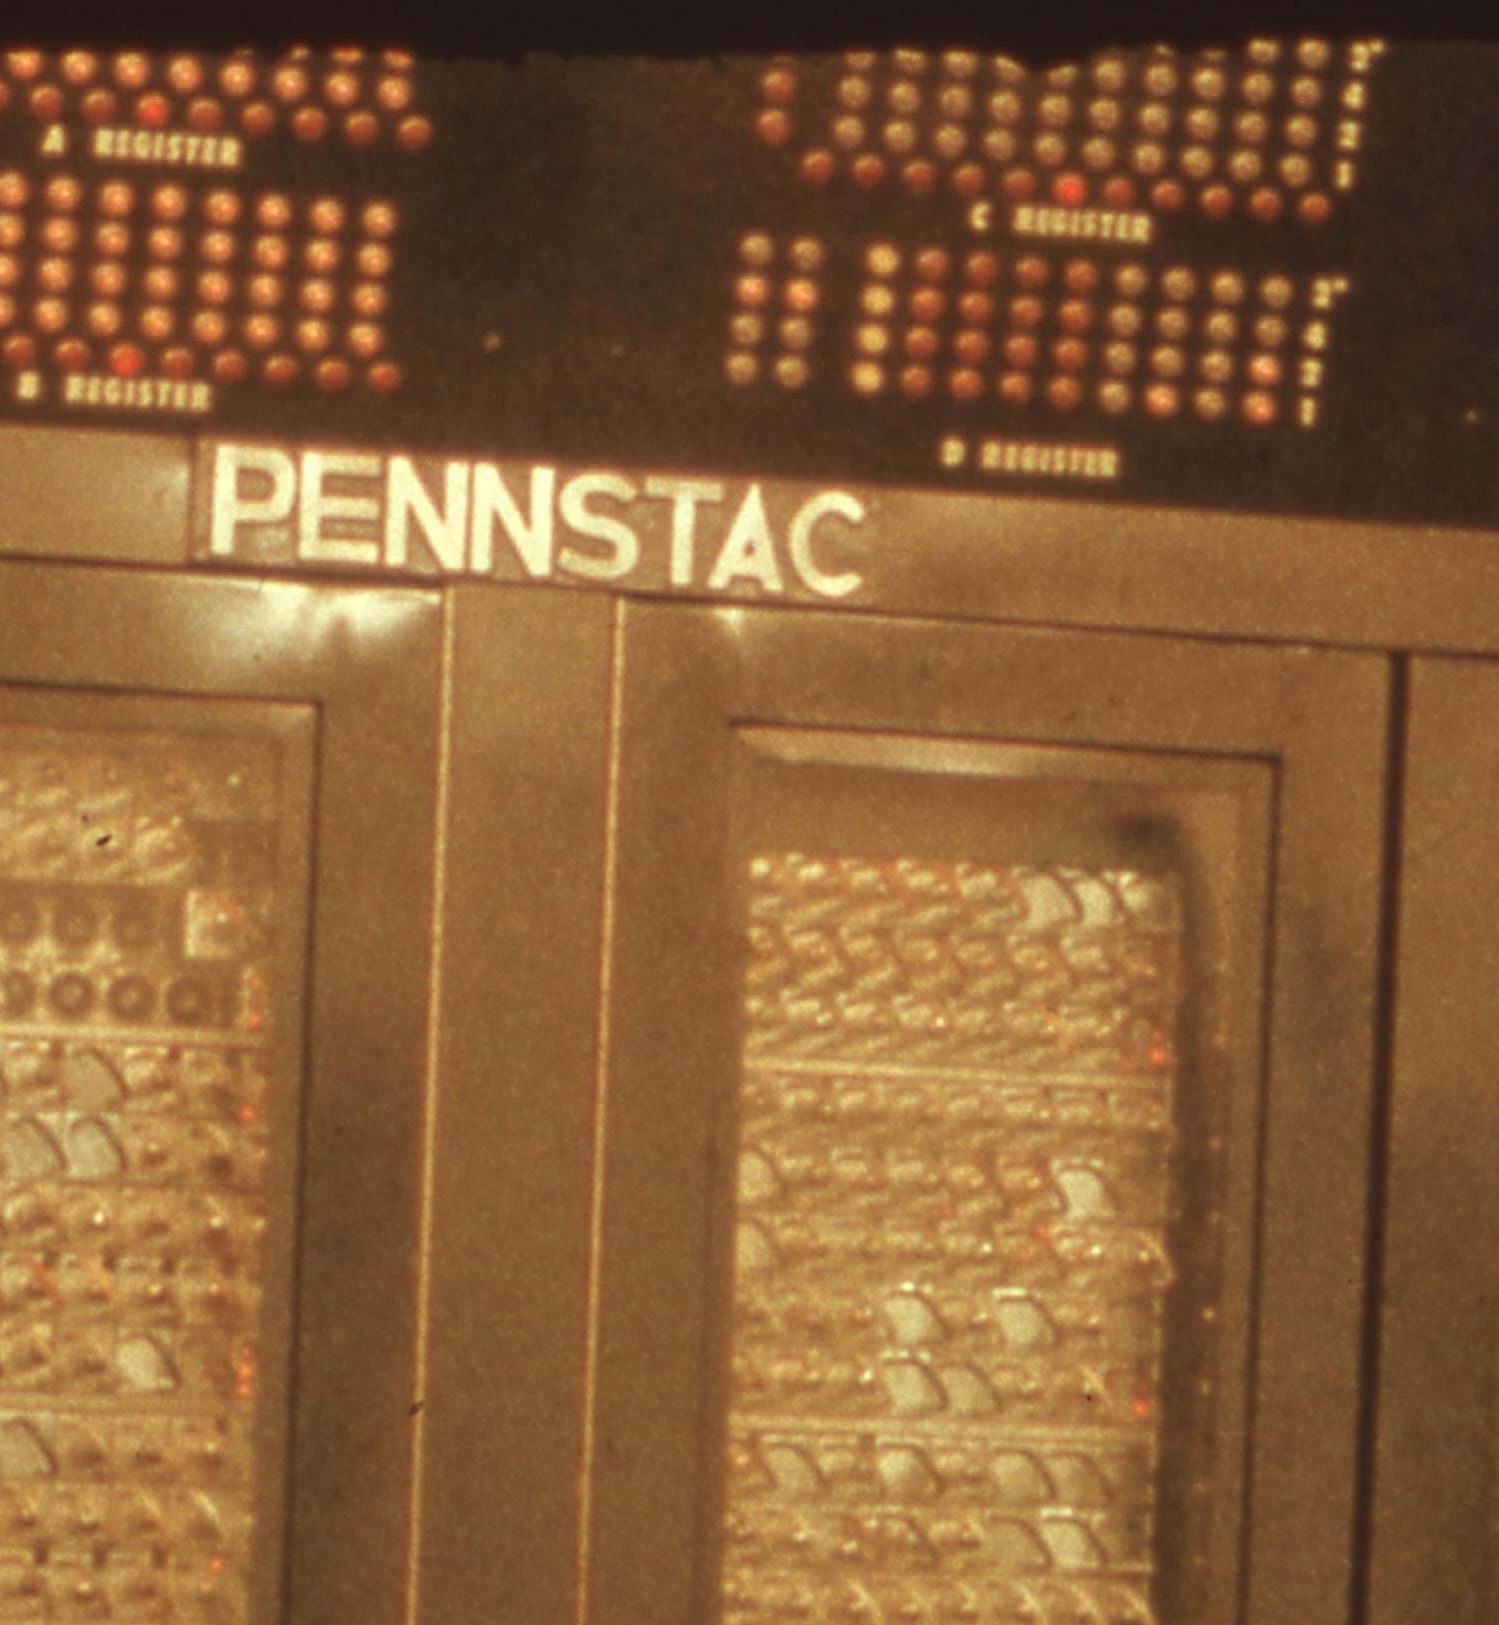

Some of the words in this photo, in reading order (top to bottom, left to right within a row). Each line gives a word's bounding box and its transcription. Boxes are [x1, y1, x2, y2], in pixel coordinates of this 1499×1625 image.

[43, 123, 64, 153] A
[94, 127, 241, 168] REGISTER
[1339, 120, 1359, 149] 2
[1336, 159, 1352, 188] 1
[971, 202, 990, 231] C
[1014, 205, 1151, 244] REGISTER
[64, 373, 211, 413] REGISTER
[981, 441, 1119, 478] REGISTER
[210, 443, 866, 598] PENNSTAC
